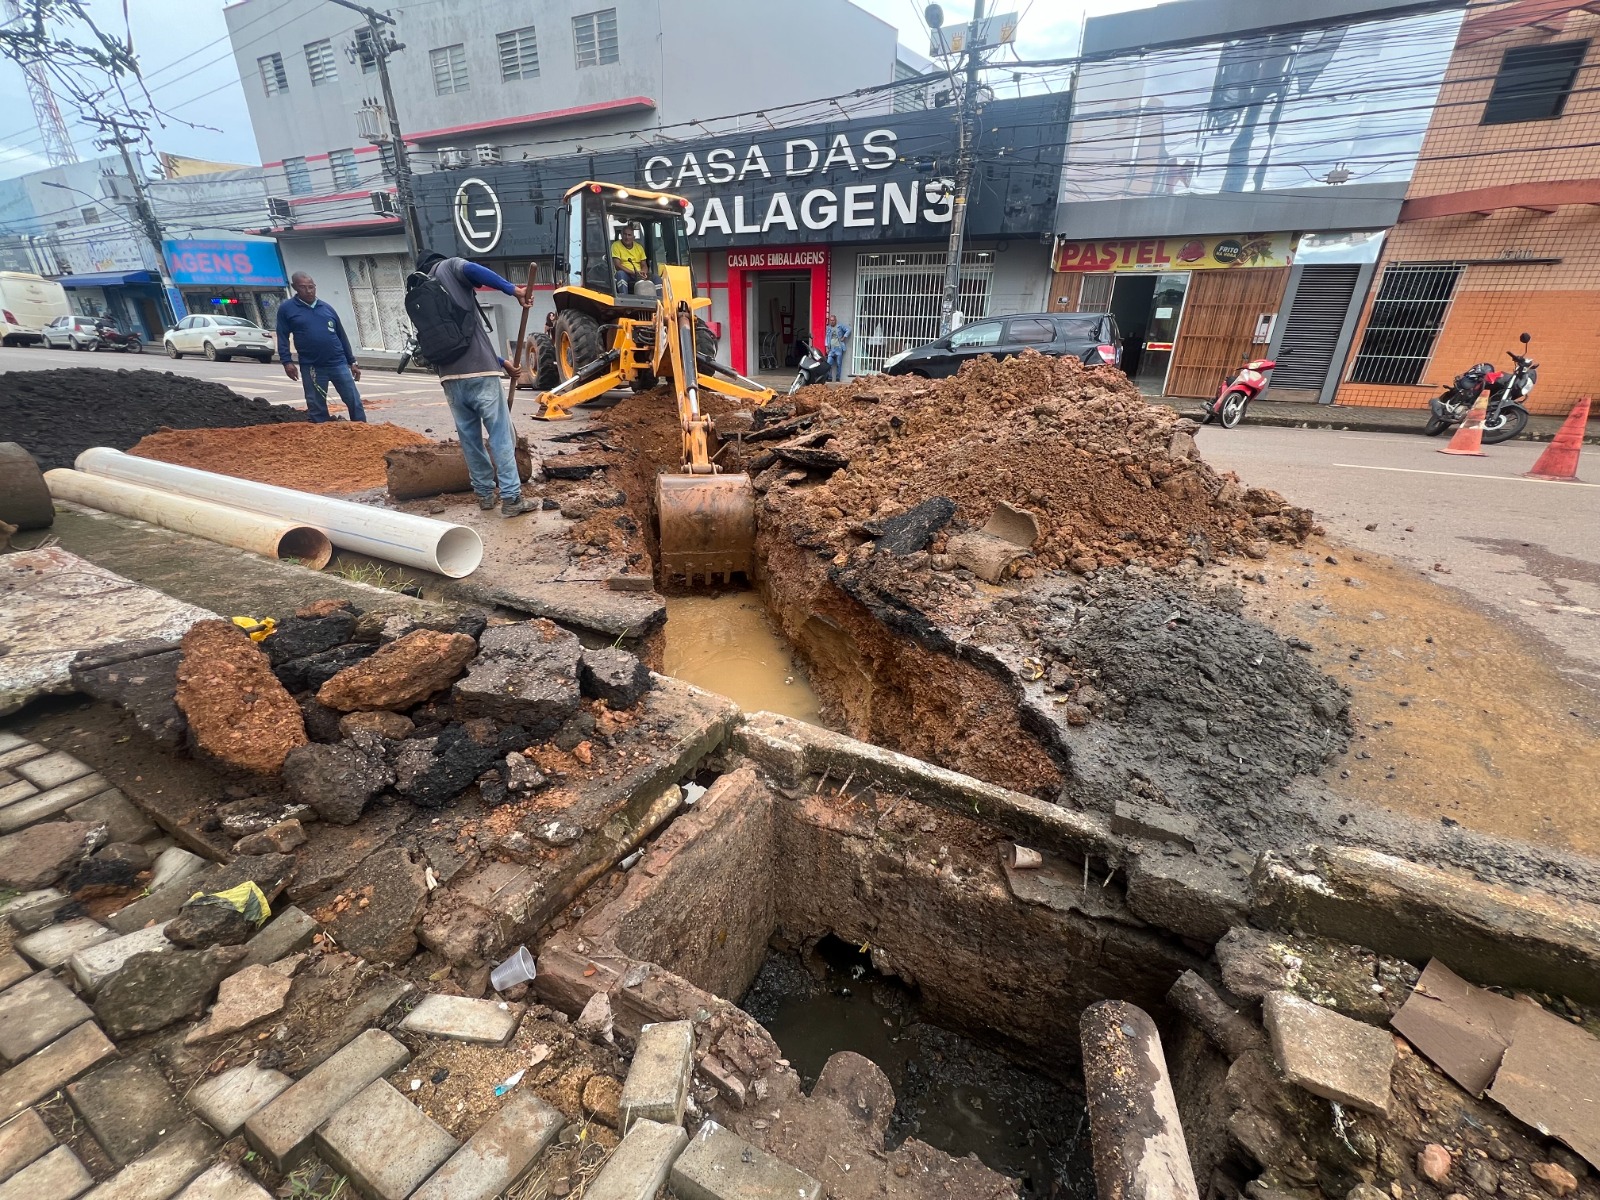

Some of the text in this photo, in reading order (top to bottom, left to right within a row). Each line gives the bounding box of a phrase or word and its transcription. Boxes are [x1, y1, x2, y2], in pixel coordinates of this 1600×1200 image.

[644, 129, 898, 190] CASA DAS
[728, 251, 825, 267] CASA DAS EMBALAGENS
[1061, 240, 1171, 266] PASTEL
[1219, 245, 1239, 254] FRITO
